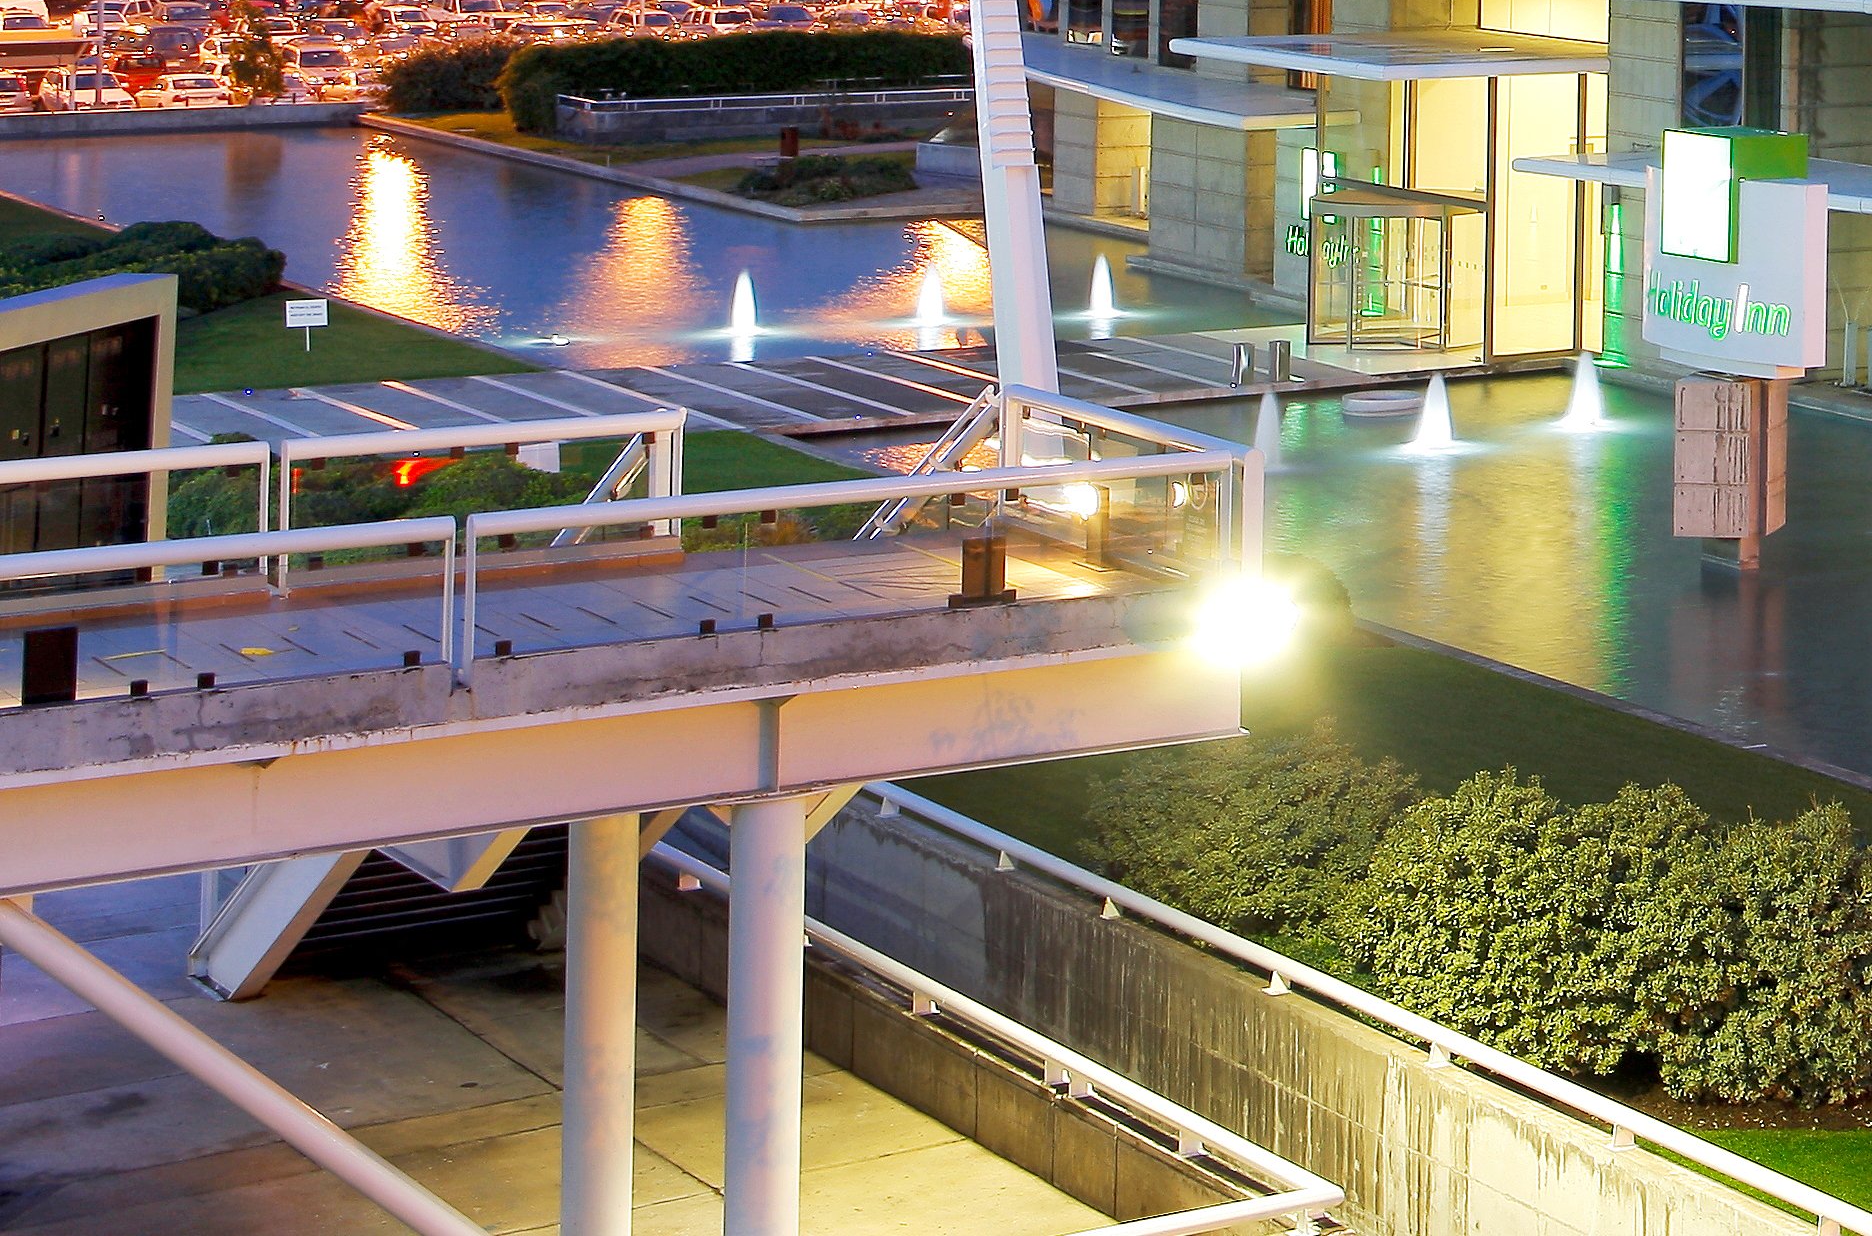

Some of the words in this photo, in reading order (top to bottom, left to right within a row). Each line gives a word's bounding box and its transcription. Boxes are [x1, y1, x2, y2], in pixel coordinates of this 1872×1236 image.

[1285, 225, 1340, 269] Holay
[1648, 268, 1733, 341] Holiday
[1734, 282, 1792, 337] Inn
